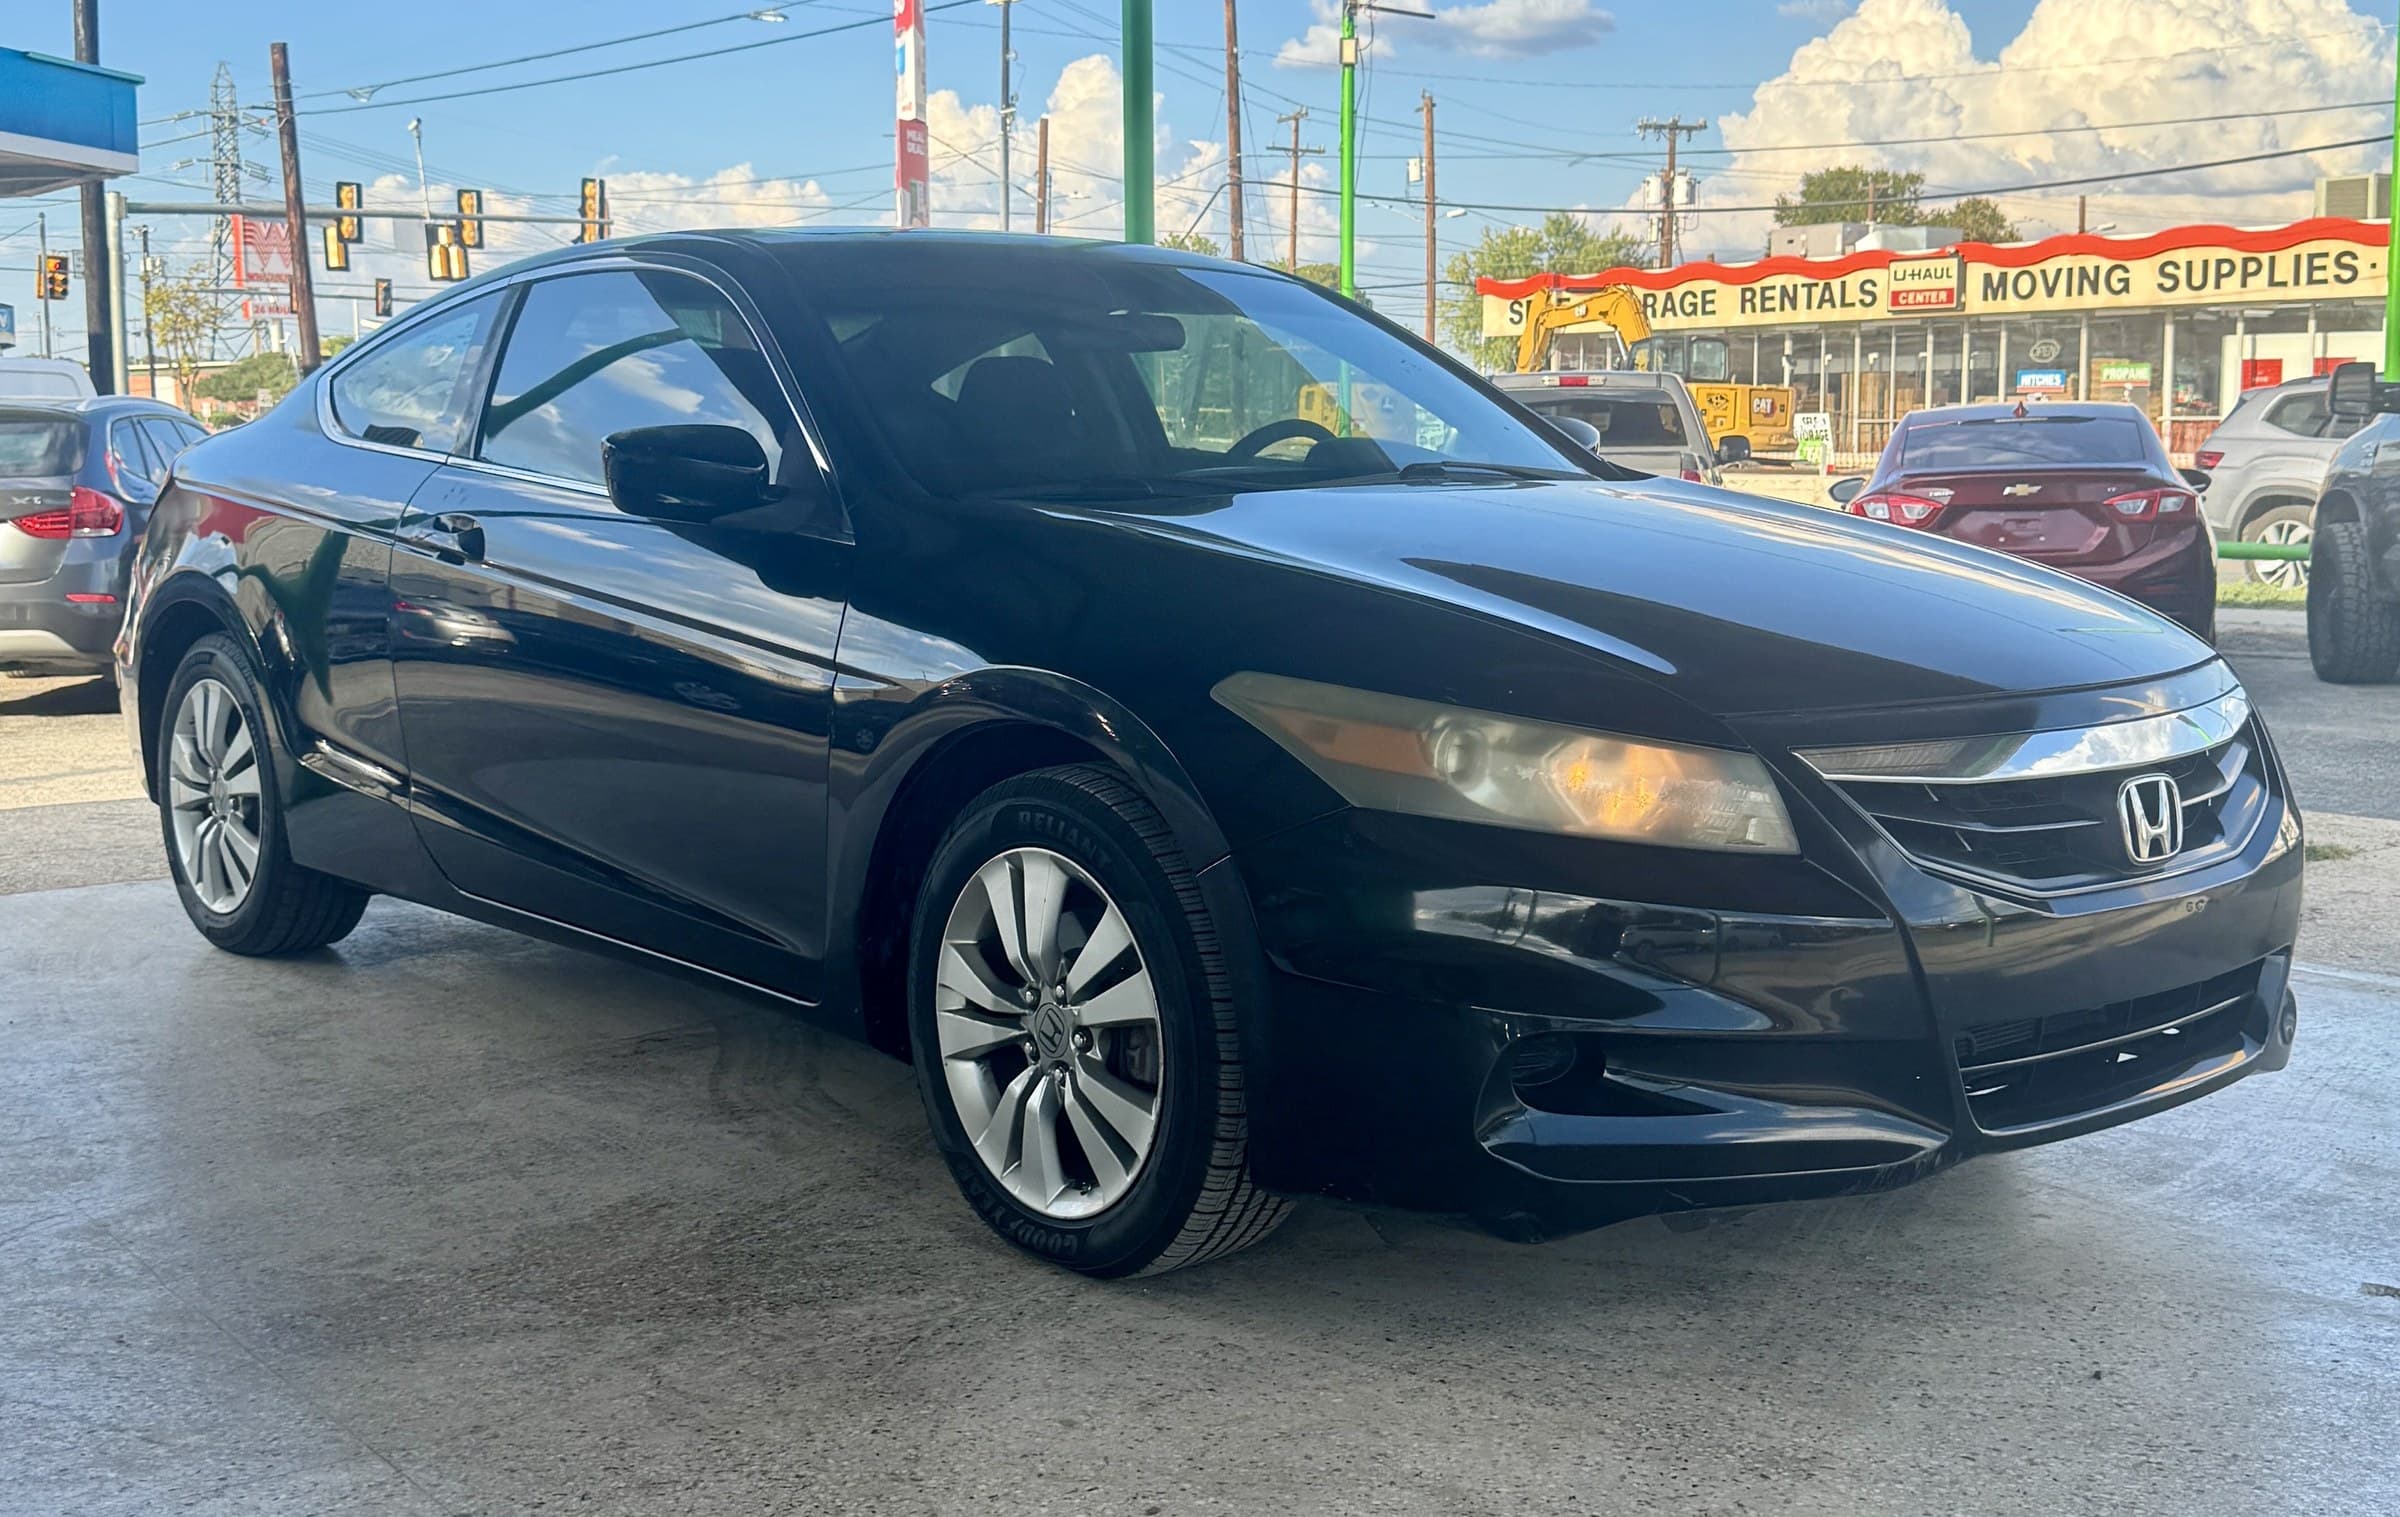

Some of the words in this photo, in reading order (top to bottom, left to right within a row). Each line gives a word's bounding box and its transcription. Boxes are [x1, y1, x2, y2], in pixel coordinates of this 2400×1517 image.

[1893, 267, 1953, 281] U-HAUL
[1982, 264, 2130, 301] MOVING
[2157, 250, 2359, 293] SUPPLIES
[1740, 279, 1877, 314] RENTALS
[1898, 290, 1948, 305] CENTER
[2020, 373, 2062, 388] HITCHES
[2102, 366, 2148, 380] PROPANE
[1753, 397, 1774, 413] CAT
